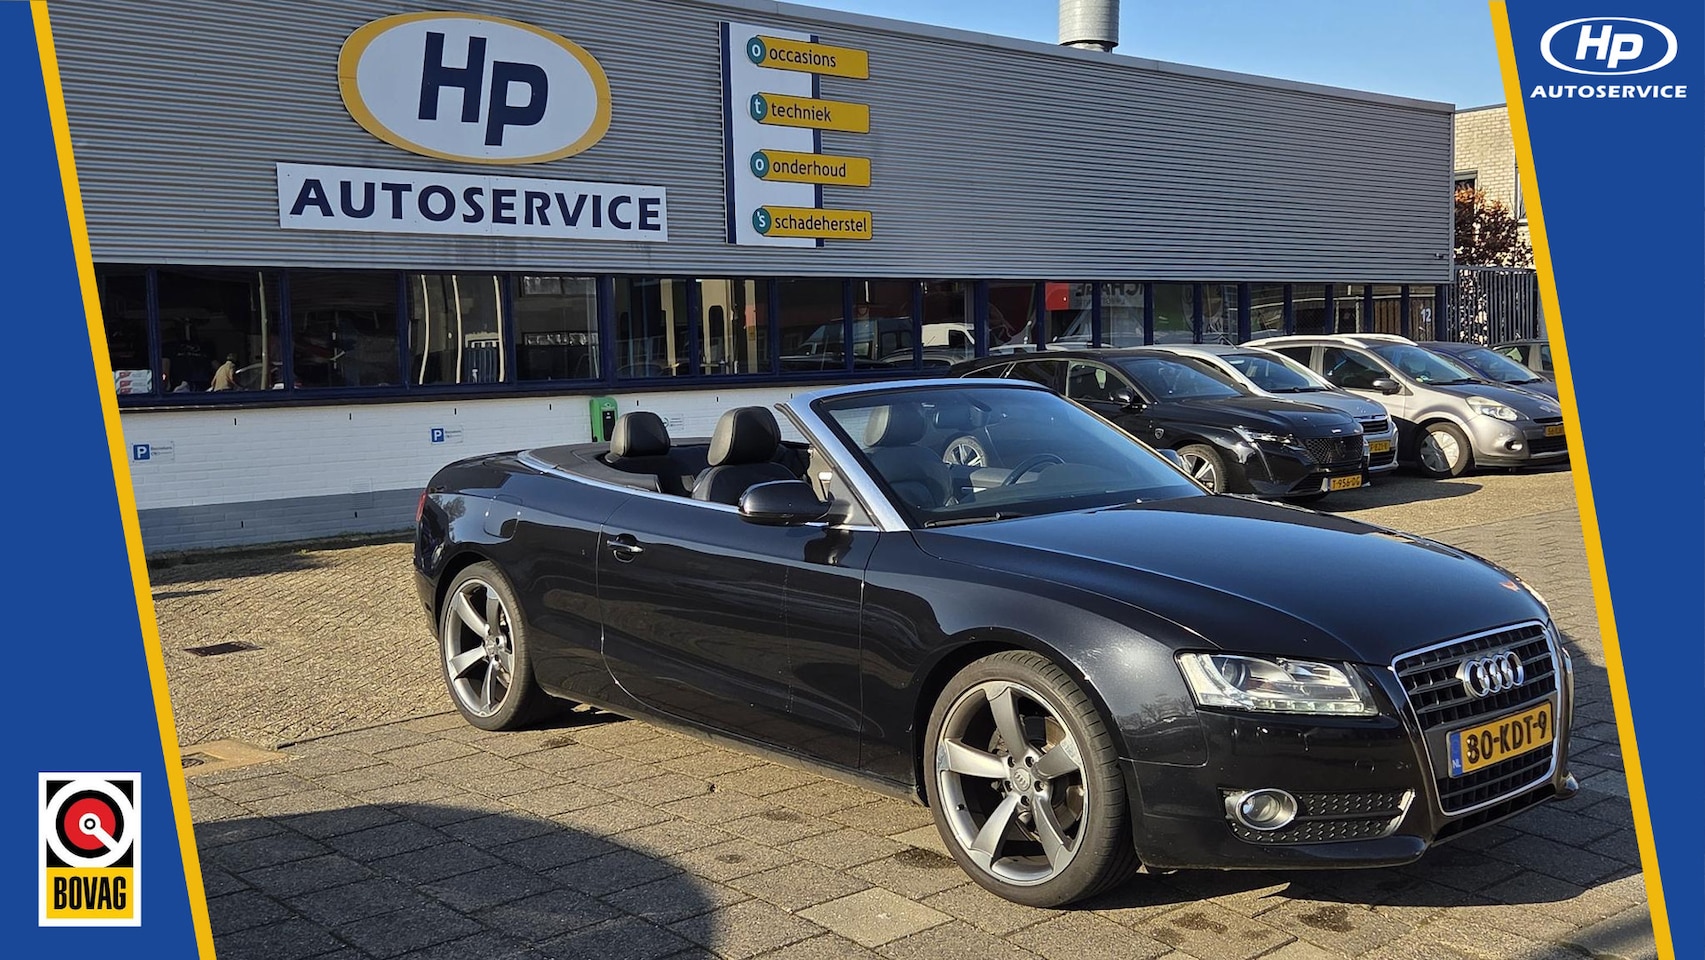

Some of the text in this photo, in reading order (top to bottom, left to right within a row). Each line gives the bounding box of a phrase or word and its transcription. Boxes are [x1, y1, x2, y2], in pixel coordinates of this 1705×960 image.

[769, 48, 836, 68] occasions
[418, 31, 548, 146] Hp
[771, 103, 832, 122] techniek
[772, 159, 846, 178] onderhoud
[290, 178, 662, 232] AUTOSERVICE
[774, 215, 867, 232] schadeherstel
[1420, 307, 1431, 322] 12
[1452, 710, 1547, 769] NL 80-KDT-9
